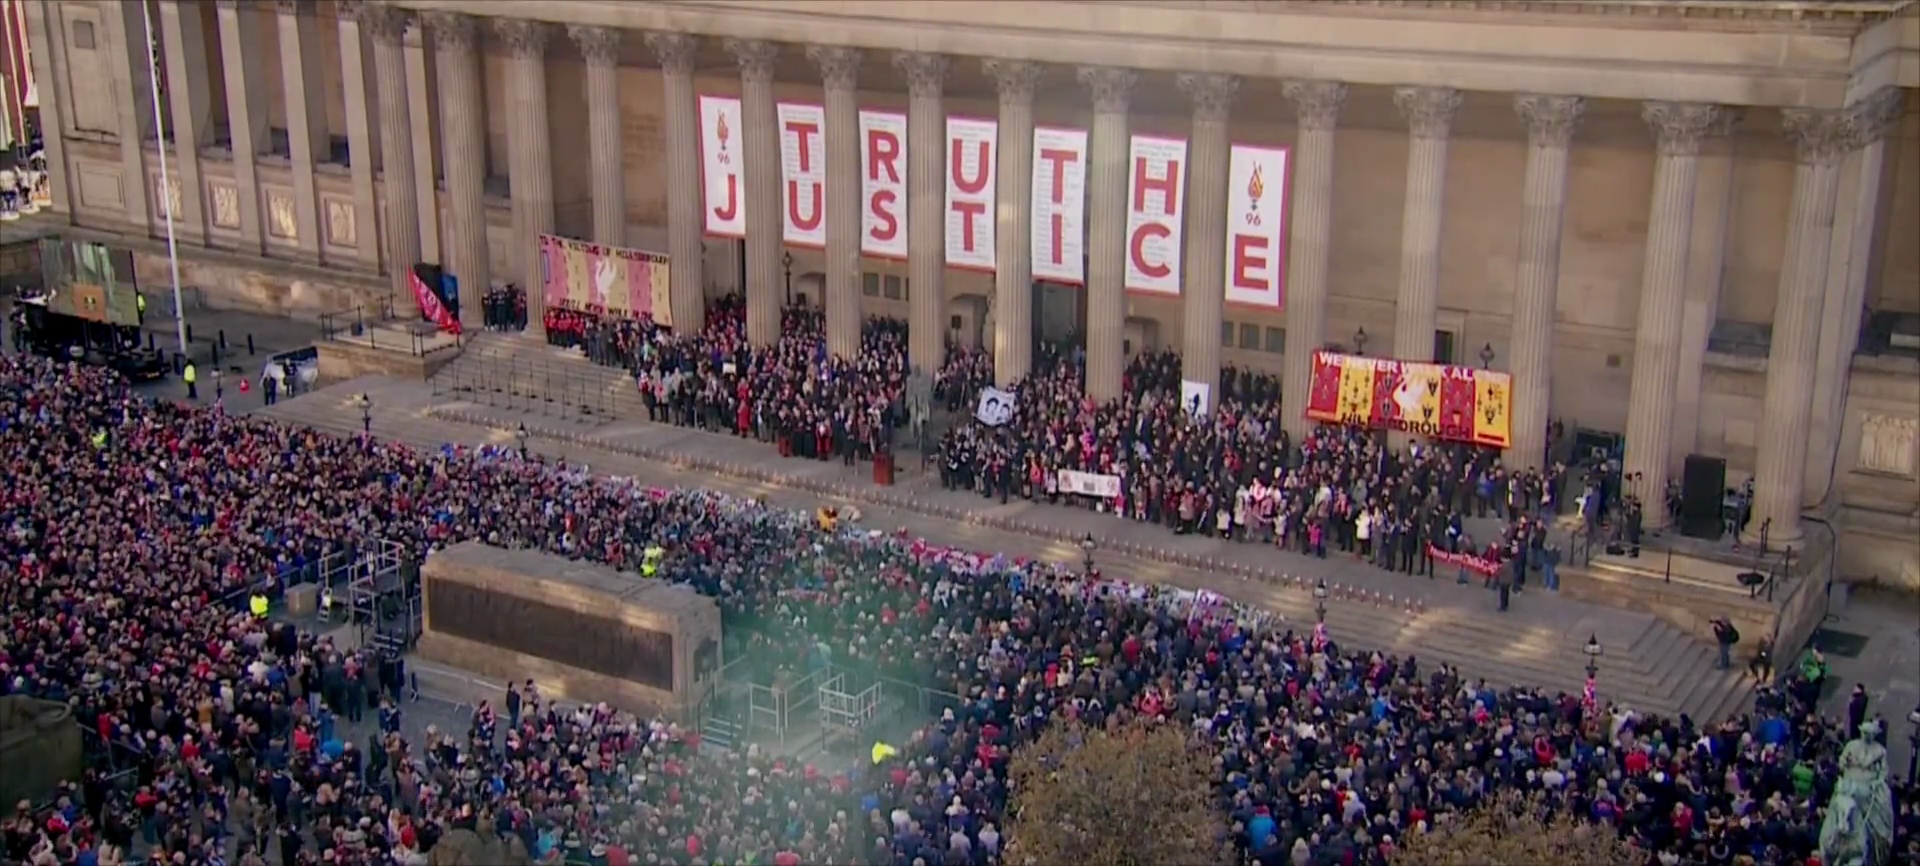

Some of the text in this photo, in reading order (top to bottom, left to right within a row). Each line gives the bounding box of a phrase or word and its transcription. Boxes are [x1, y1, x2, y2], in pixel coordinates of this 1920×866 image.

[717, 153, 730, 165] 96
[785, 121, 818, 172] T
[868, 130, 900, 184] R
[952, 139, 990, 194] U
[1040, 149, 1078, 204] T
[1134, 157, 1179, 215] H
[1245, 213, 1261, 226] 96
[714, 174, 1269, 291] J U S T I C E
[1319, 351, 1343, 368] WE
